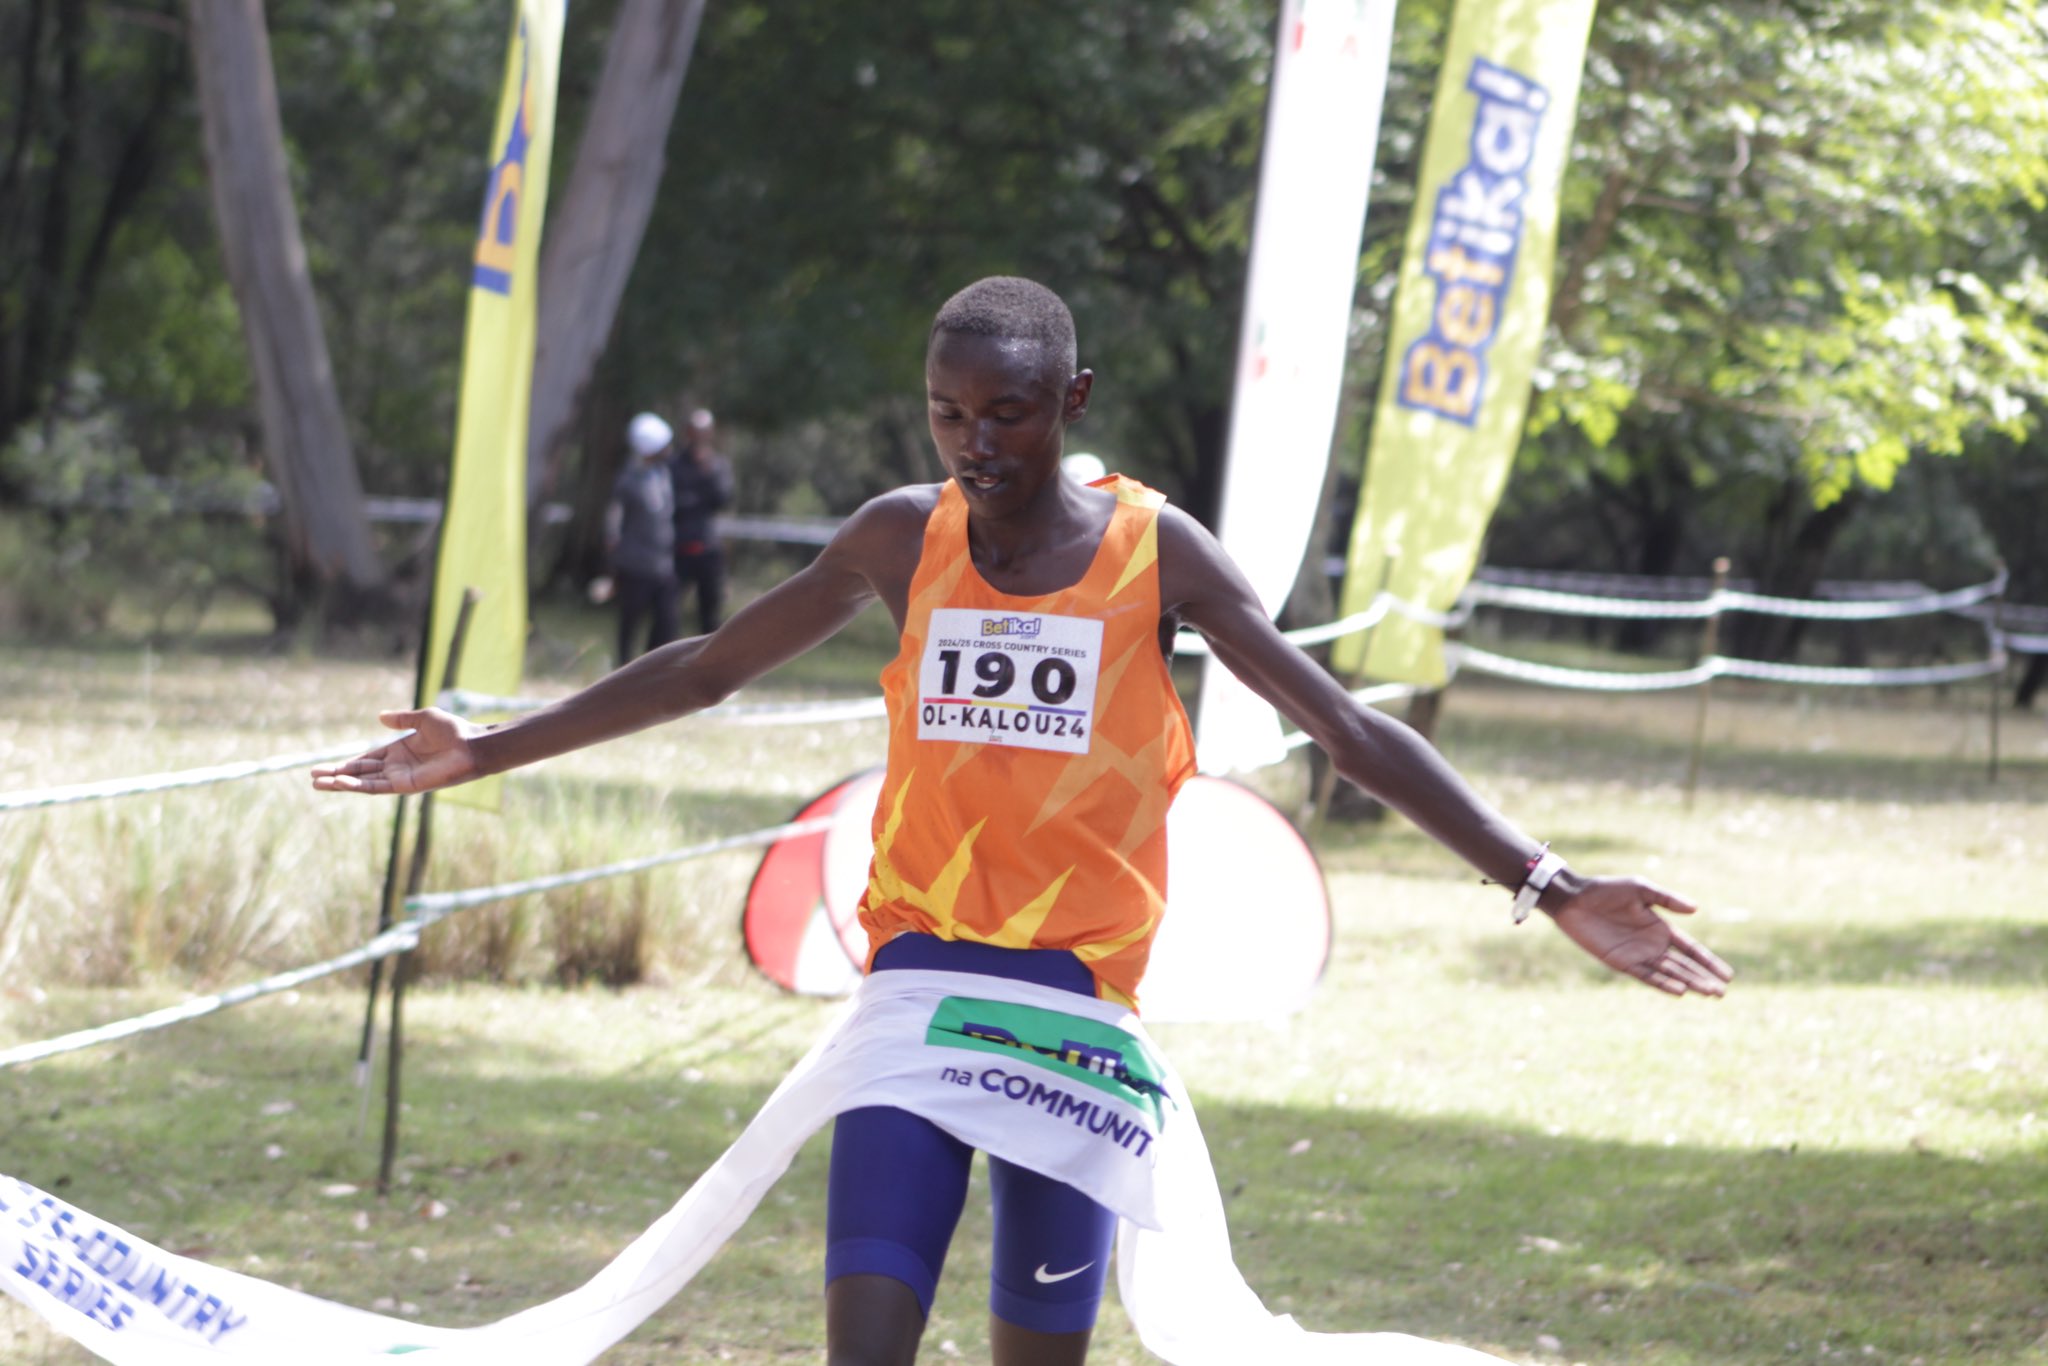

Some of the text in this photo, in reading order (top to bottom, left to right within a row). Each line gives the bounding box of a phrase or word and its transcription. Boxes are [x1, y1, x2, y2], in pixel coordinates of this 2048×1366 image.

[1396, 55, 1551, 428] Betika!
[938, 639, 1087, 658] 2024/25 CROSS COUNTRY SERIES
[981, 617, 1041, 637] Betika!
[938, 650, 1077, 705] 190
[923, 705, 1085, 739] OL-KALOU24
[941, 1067, 1154, 1158] na COMMUNIT
